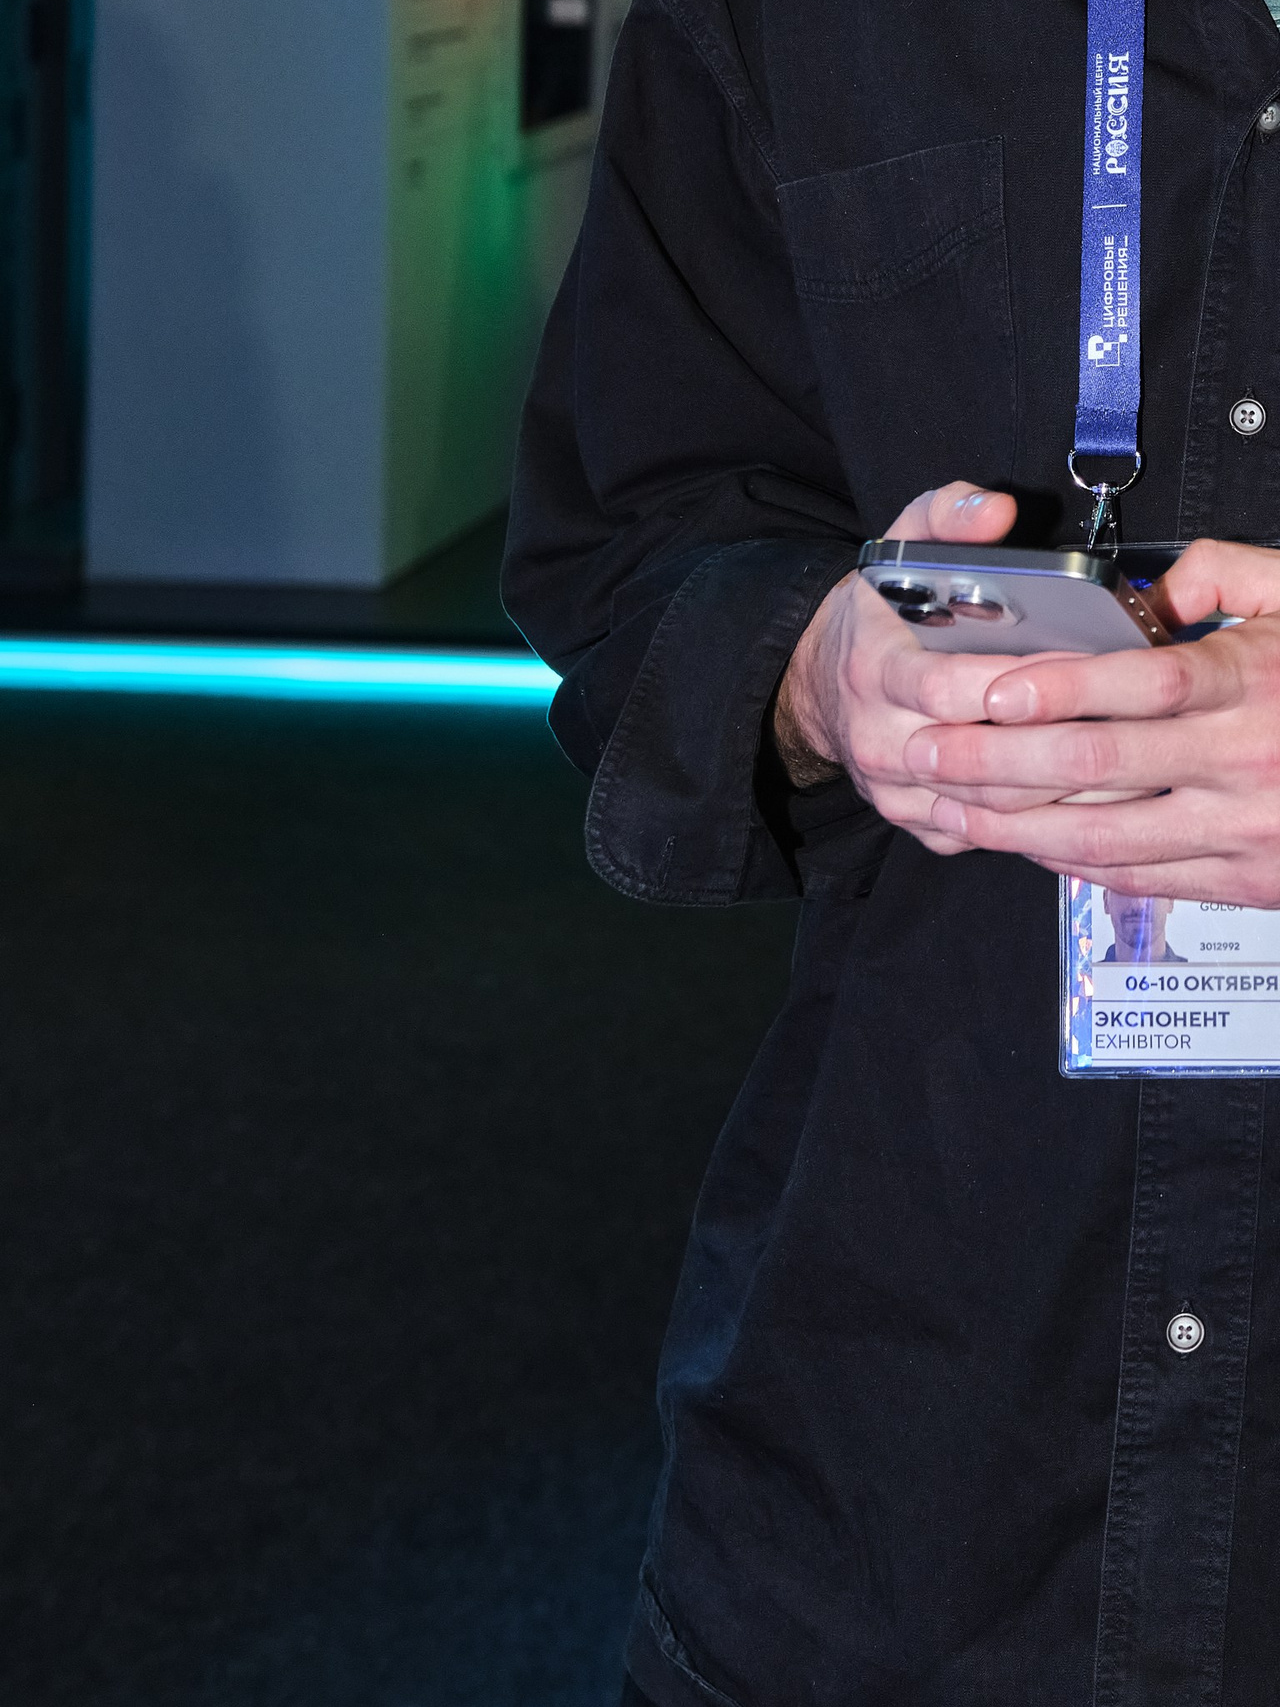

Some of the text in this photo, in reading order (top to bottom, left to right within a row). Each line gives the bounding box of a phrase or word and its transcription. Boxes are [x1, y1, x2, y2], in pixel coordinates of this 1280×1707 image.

[1092, 52, 1103, 176] НАЦИОНАЛЬНЫЙ ЦЕНТР
[1105, 51, 1130, 176] РОССИЯ
[1103, 235, 1116, 329] ЦИФРОВЫЕ
[1200, 942, 1240, 951] 3012992
[1125, 975, 1179, 991] 06-10
[1184, 975, 1279, 991] ОКТЯБРЯ
[1095, 1011, 1230, 1027] ЭКСПОНЕНТ
[1095, 1034, 1192, 1050] EXHIBITOR
